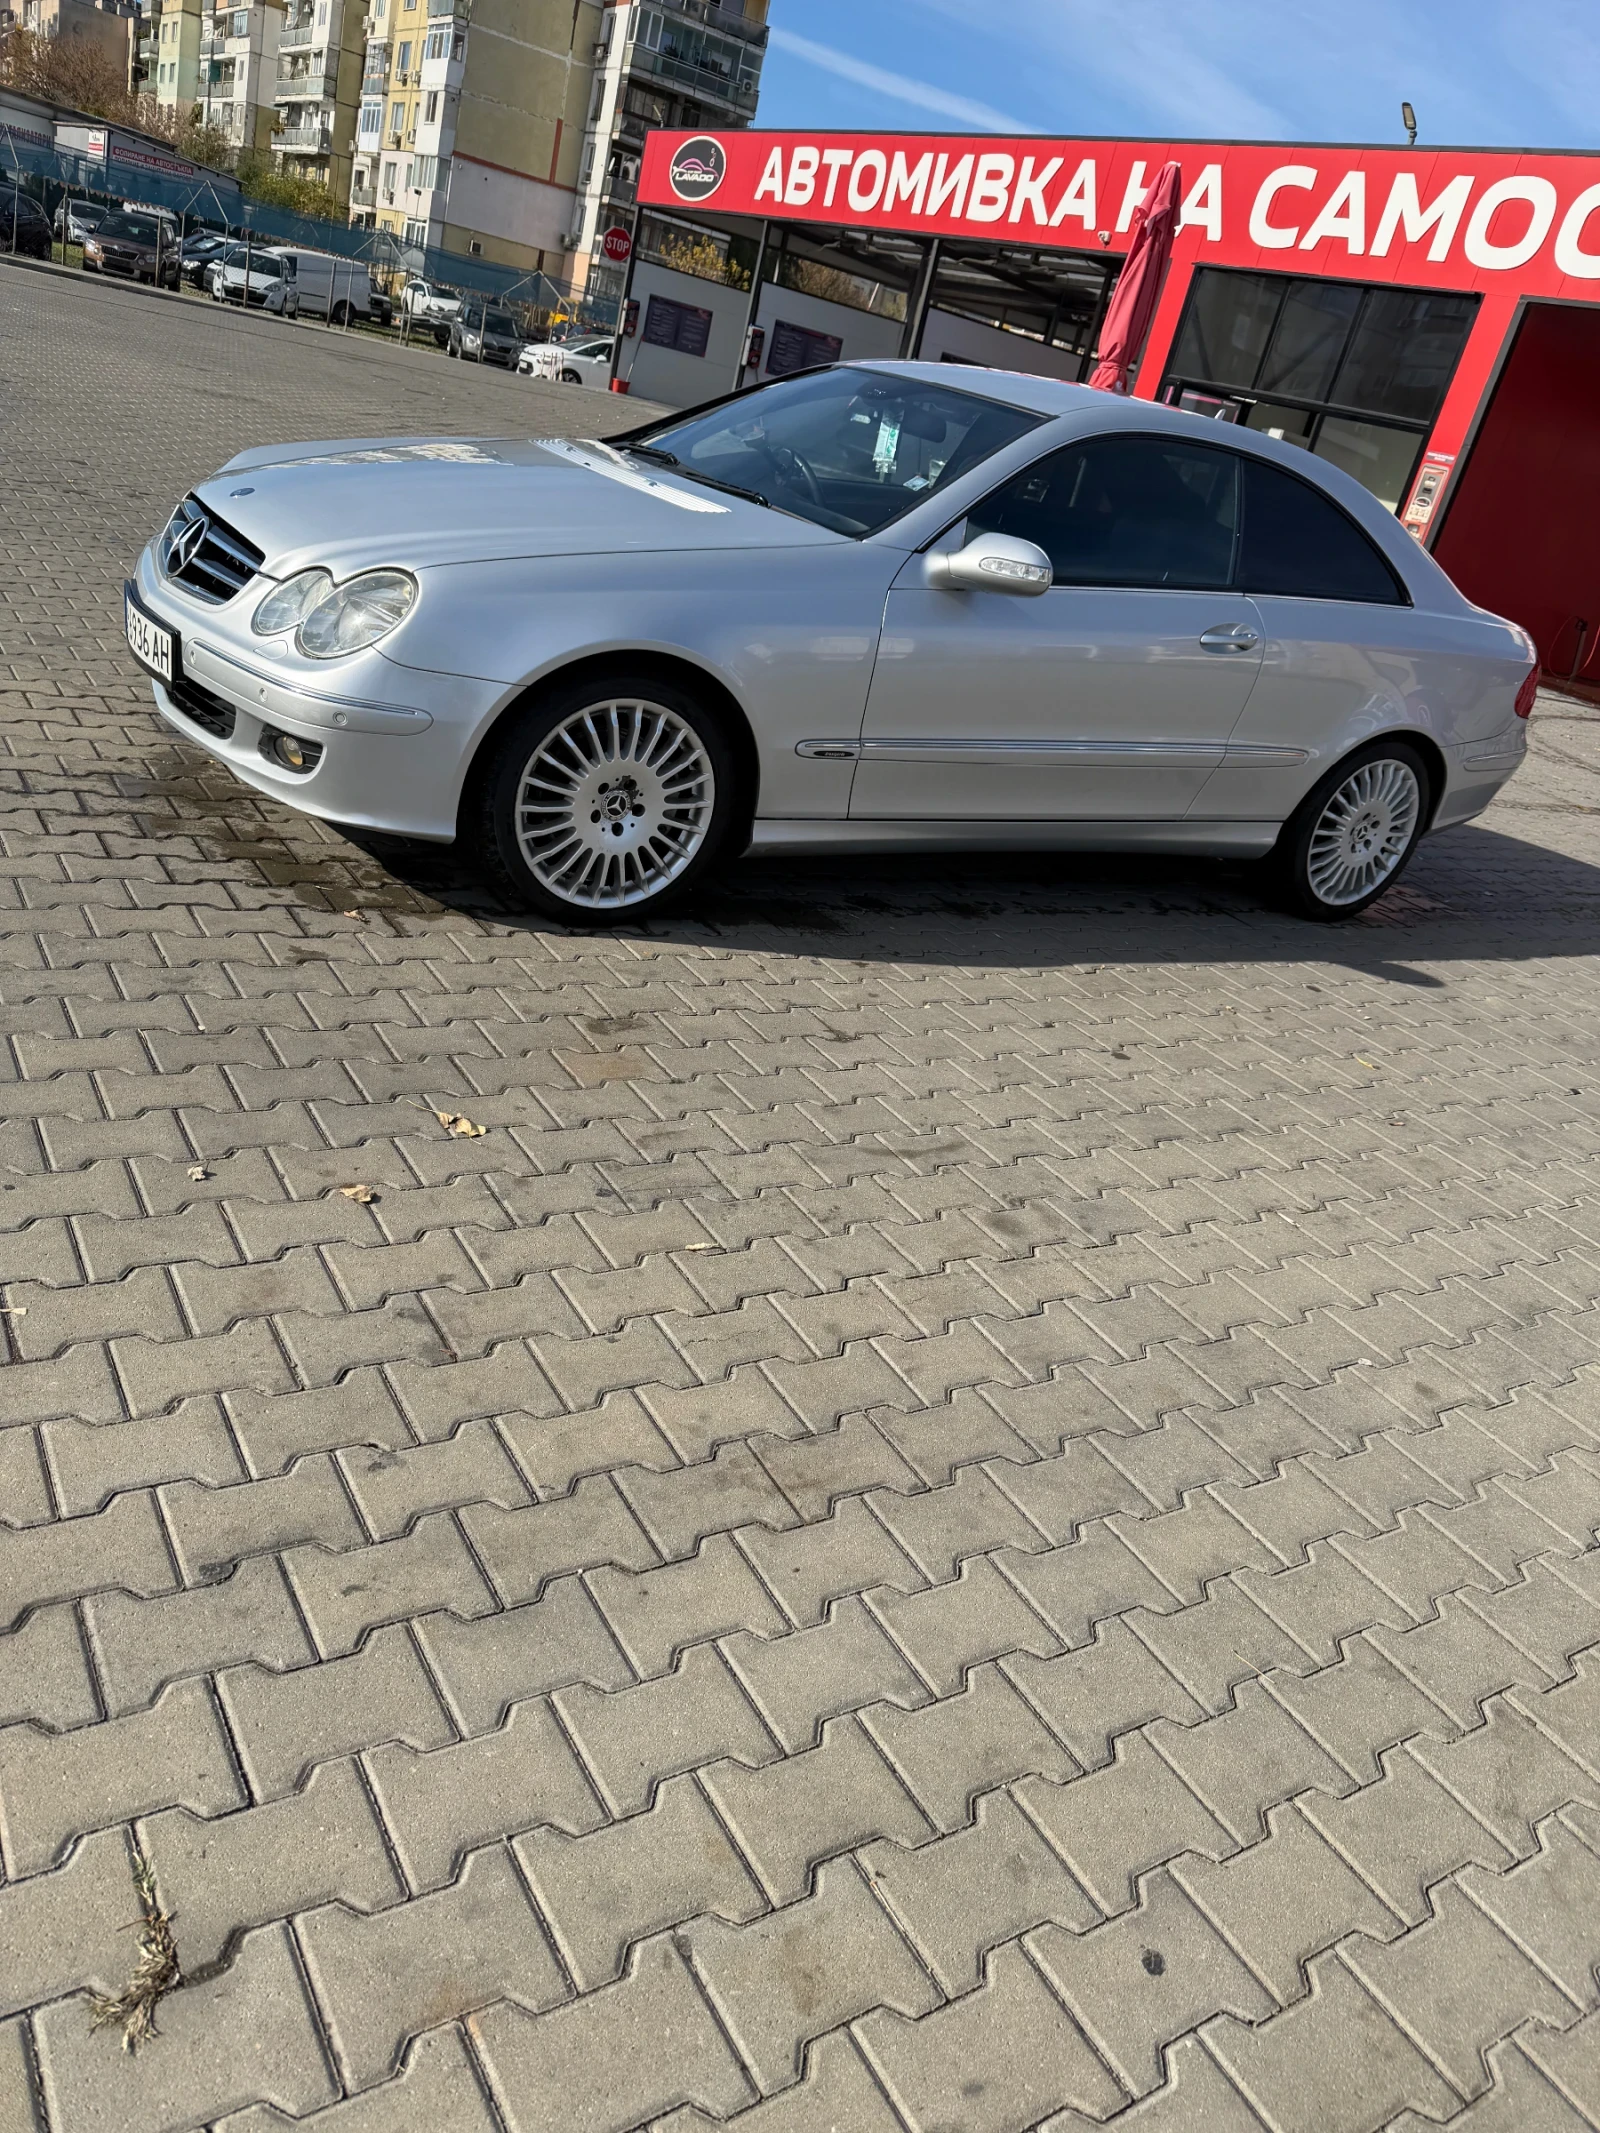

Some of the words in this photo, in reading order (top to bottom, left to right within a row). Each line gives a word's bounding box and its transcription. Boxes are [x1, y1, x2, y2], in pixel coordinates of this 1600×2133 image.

[675, 172, 715, 182] LAVADO
[754, 146, 1097, 230] АВТОМИВКА
[606, 236, 630, 253] STOP
